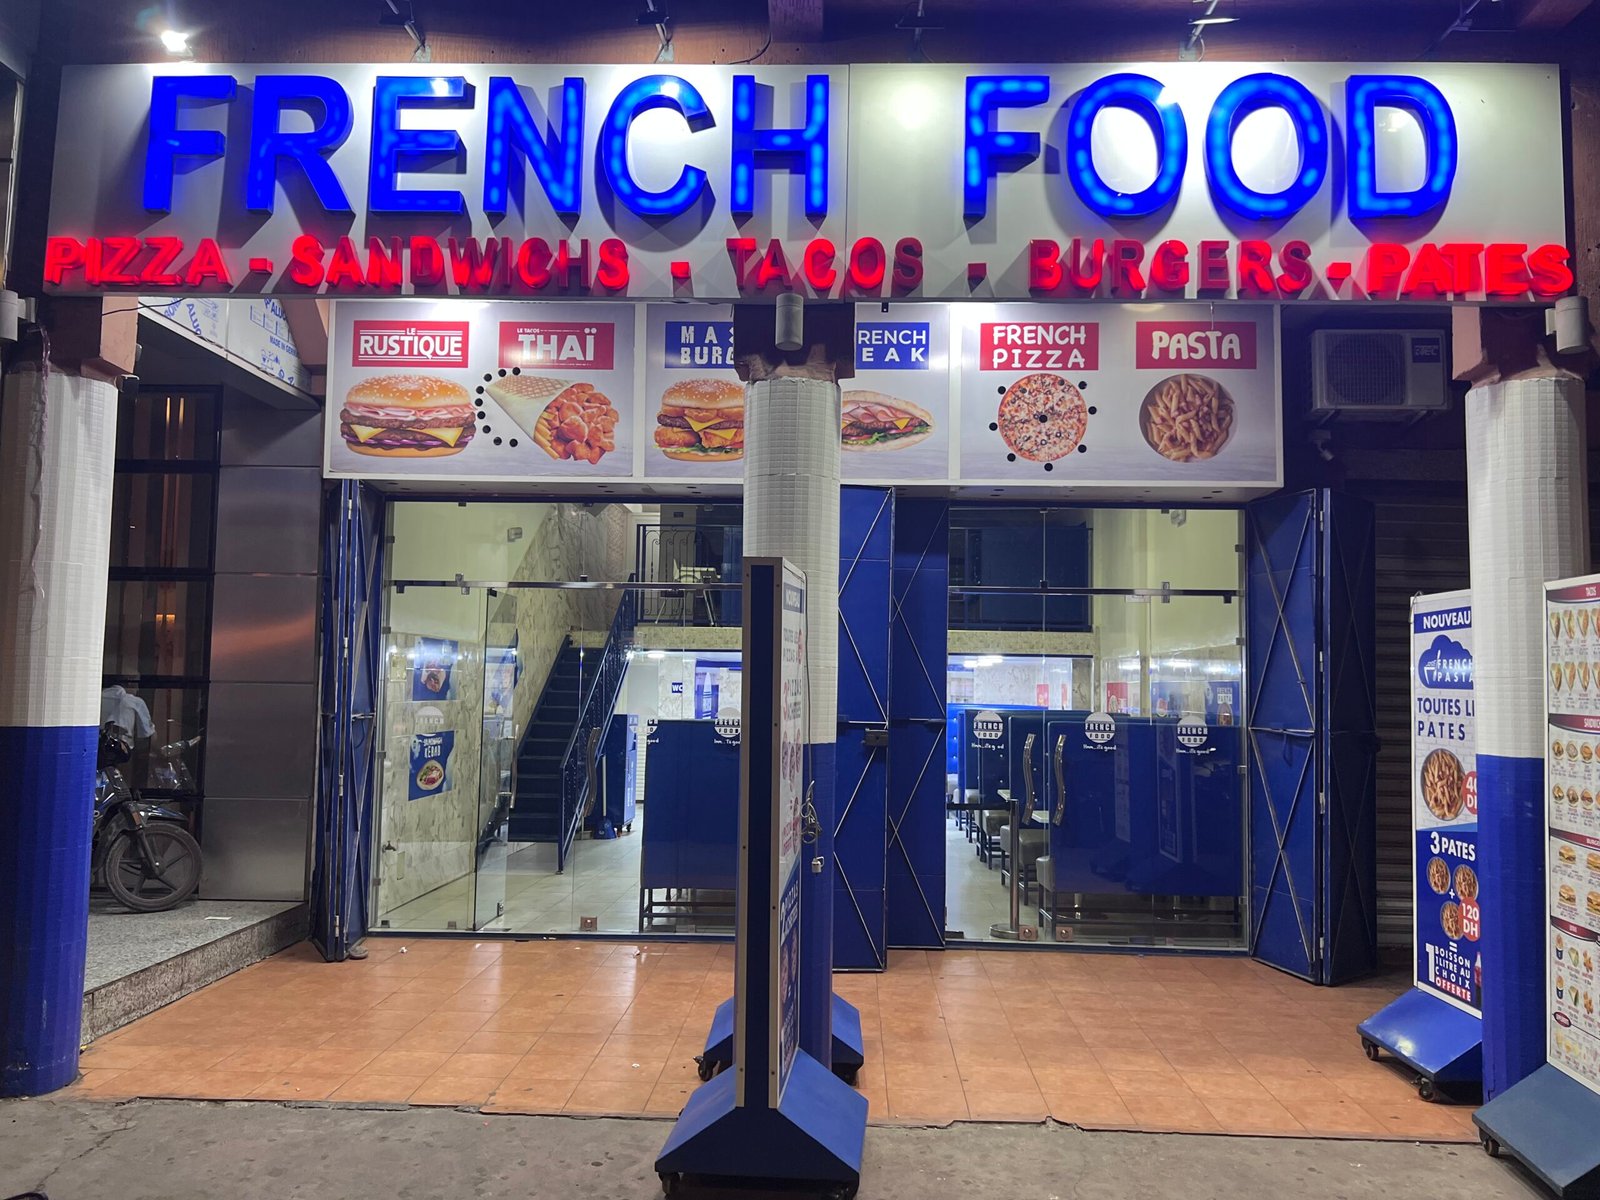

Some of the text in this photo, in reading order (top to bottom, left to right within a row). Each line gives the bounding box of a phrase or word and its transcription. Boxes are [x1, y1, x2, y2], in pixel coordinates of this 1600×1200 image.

[143, 73, 1458, 221] FRENCH FOOD
[44, 237, 230, 287] PIZZA
[291, 236, 630, 290] SANDWICHS
[728, 237, 923, 291] TACOS
[1028, 239, 1312, 294] BURGERS
[1368, 242, 1574, 295] PATES
[518, 328, 597, 361] THAÏ
[858, 330, 926, 344] RENCH
[992, 324, 1086, 345] FRENCH
[1152, 330, 1241, 360] PASTA
[360, 335, 462, 359] RUSTIQUE
[862, 348, 926, 362] EAK
[992, 348, 1086, 368] PIZZA
[1423, 610, 1471, 629] NOUVEAU
[1417, 698, 1461, 716] TOUTES
[1418, 720, 1465, 740] PATES
[1430, 832, 1476, 861] 3 PATES
[1462, 903, 1479, 920] 120
[1463, 922, 1478, 938] DH
[1435, 946, 1470, 968] BOISSON
[1436, 966, 1470, 989] CHOIX
[1440, 958, 1457, 973] LITRE
[1460, 968, 1470, 978] AU
[1436, 976, 1471, 1002] OFFERTE
